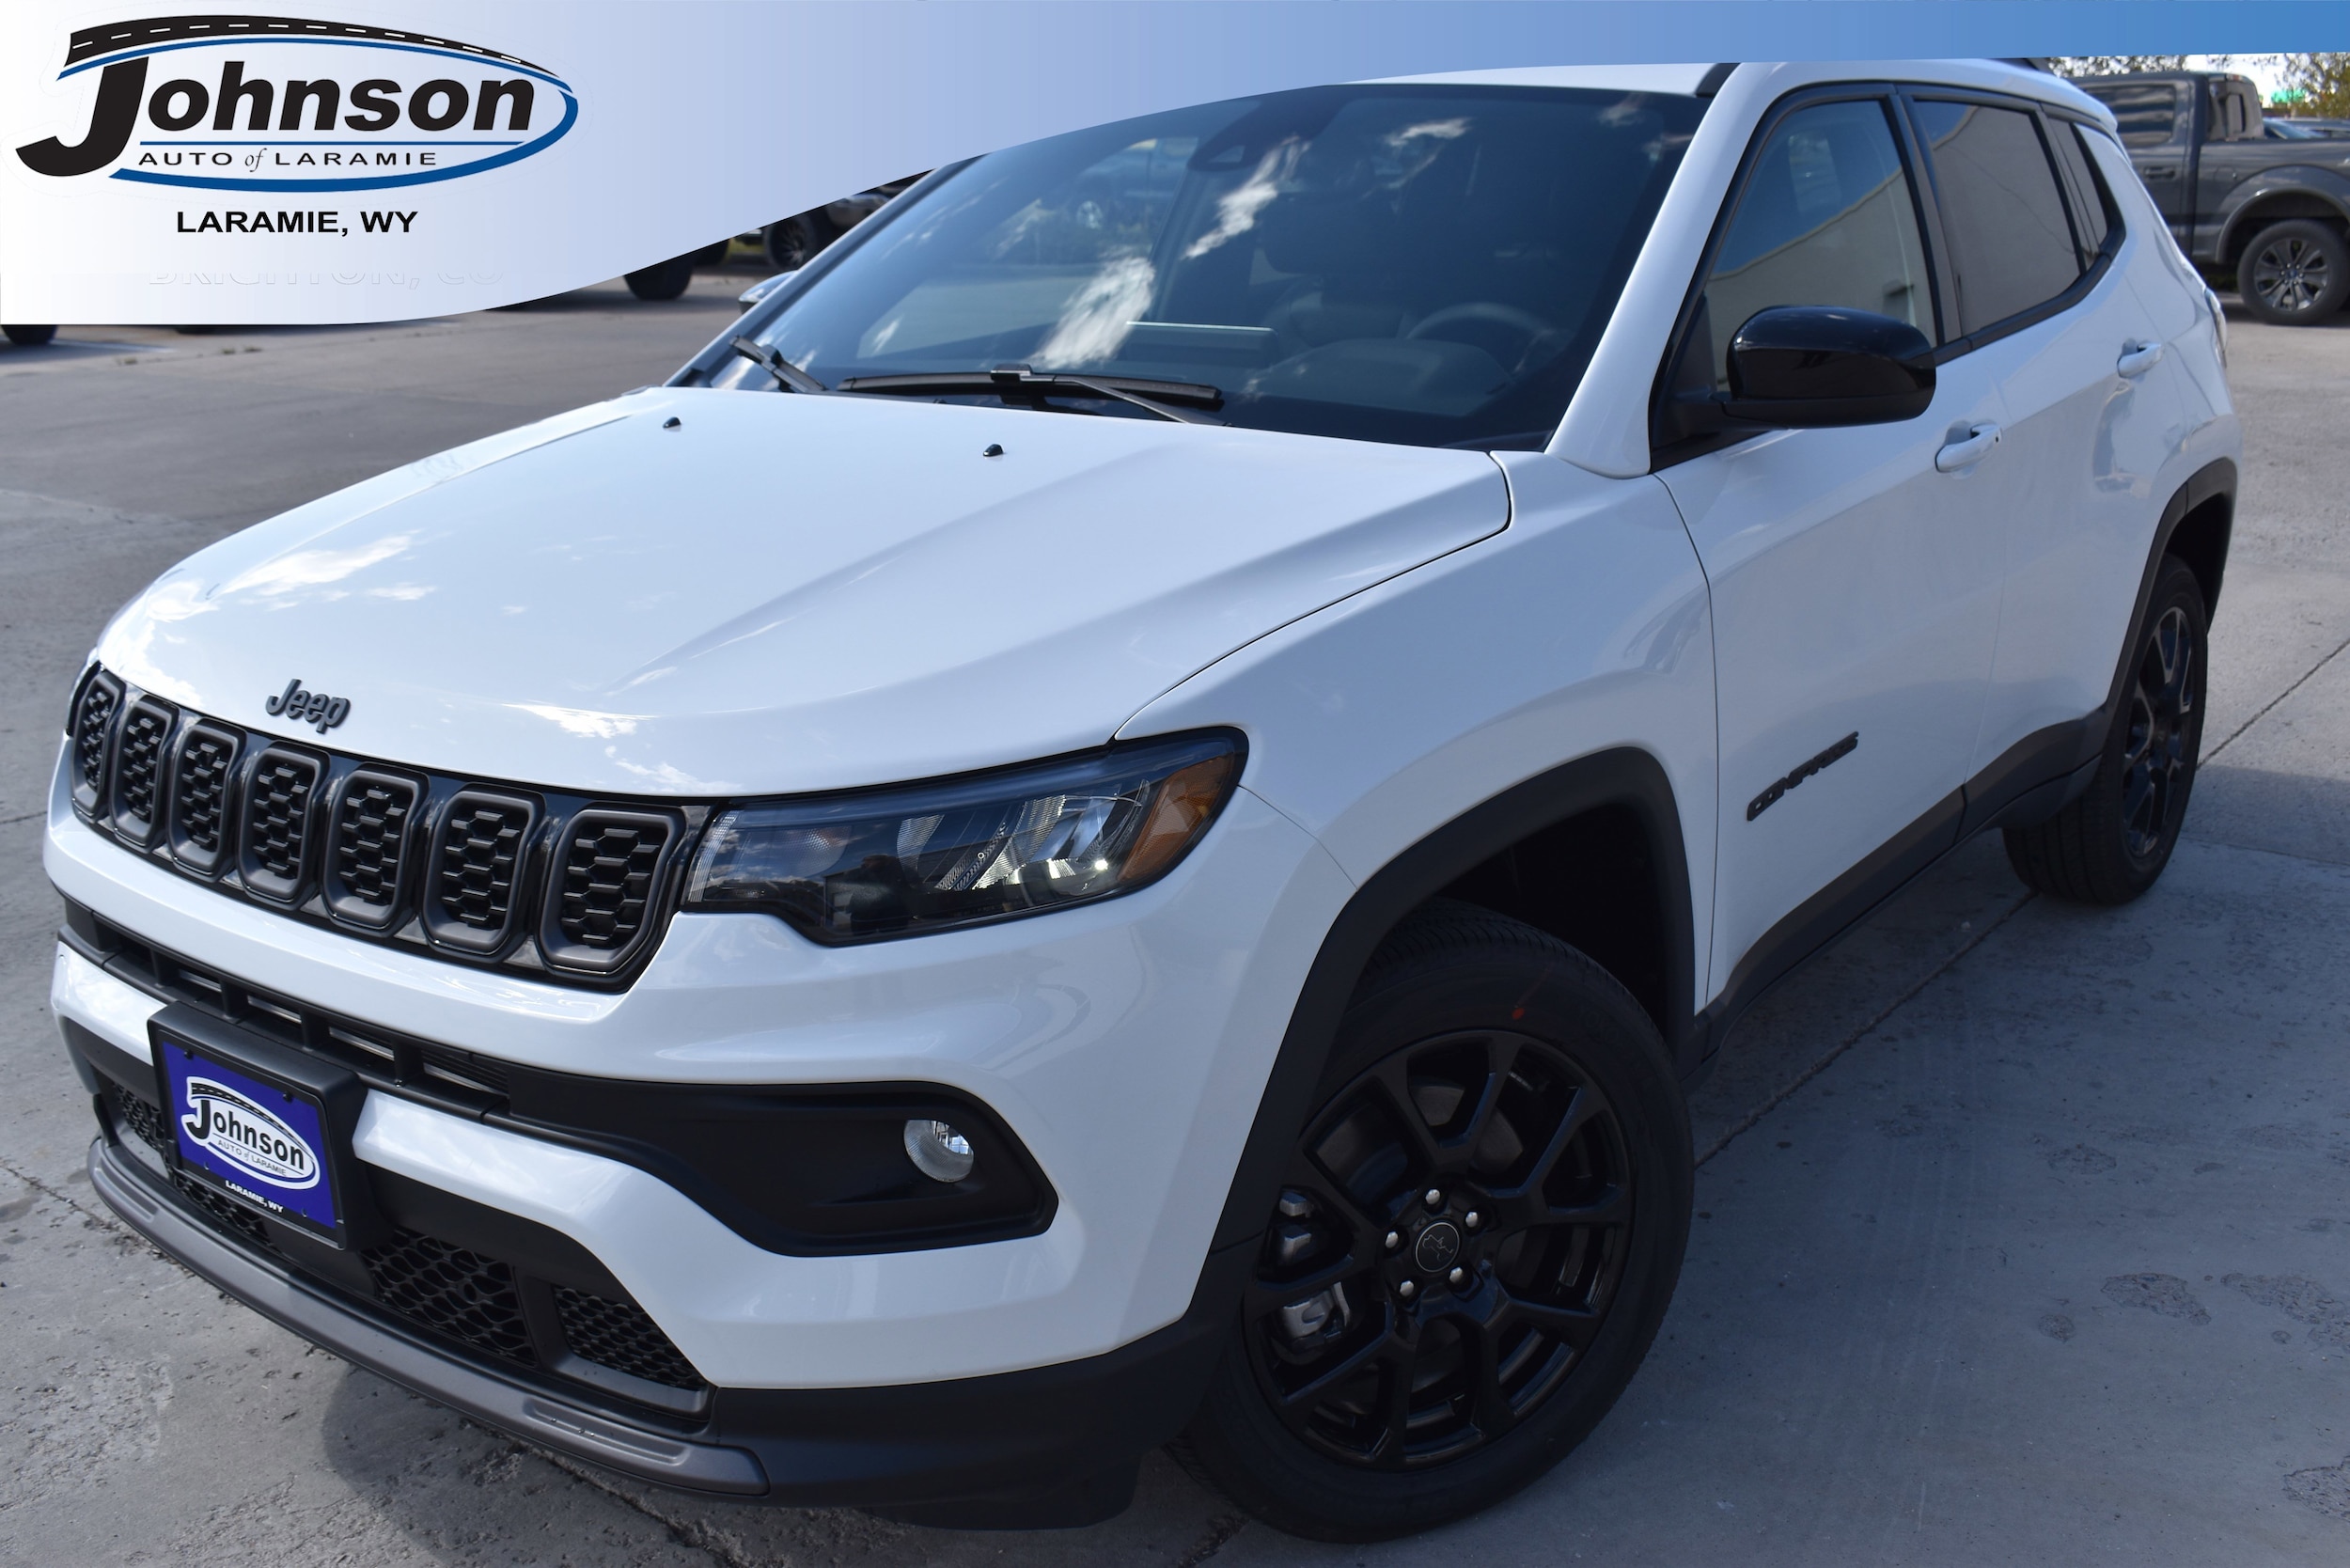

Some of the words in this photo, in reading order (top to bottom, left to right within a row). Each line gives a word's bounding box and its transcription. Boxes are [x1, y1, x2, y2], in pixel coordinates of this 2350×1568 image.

[265, 678, 352, 735] Jeep
[186, 1099, 305, 1170] Johnson
[218, 1140, 243, 1154] AUTO
[252, 1156, 287, 1176] LARAMIE
[226, 1180, 268, 1207] LARAMIE,
[269, 1200, 284, 1213] WY
